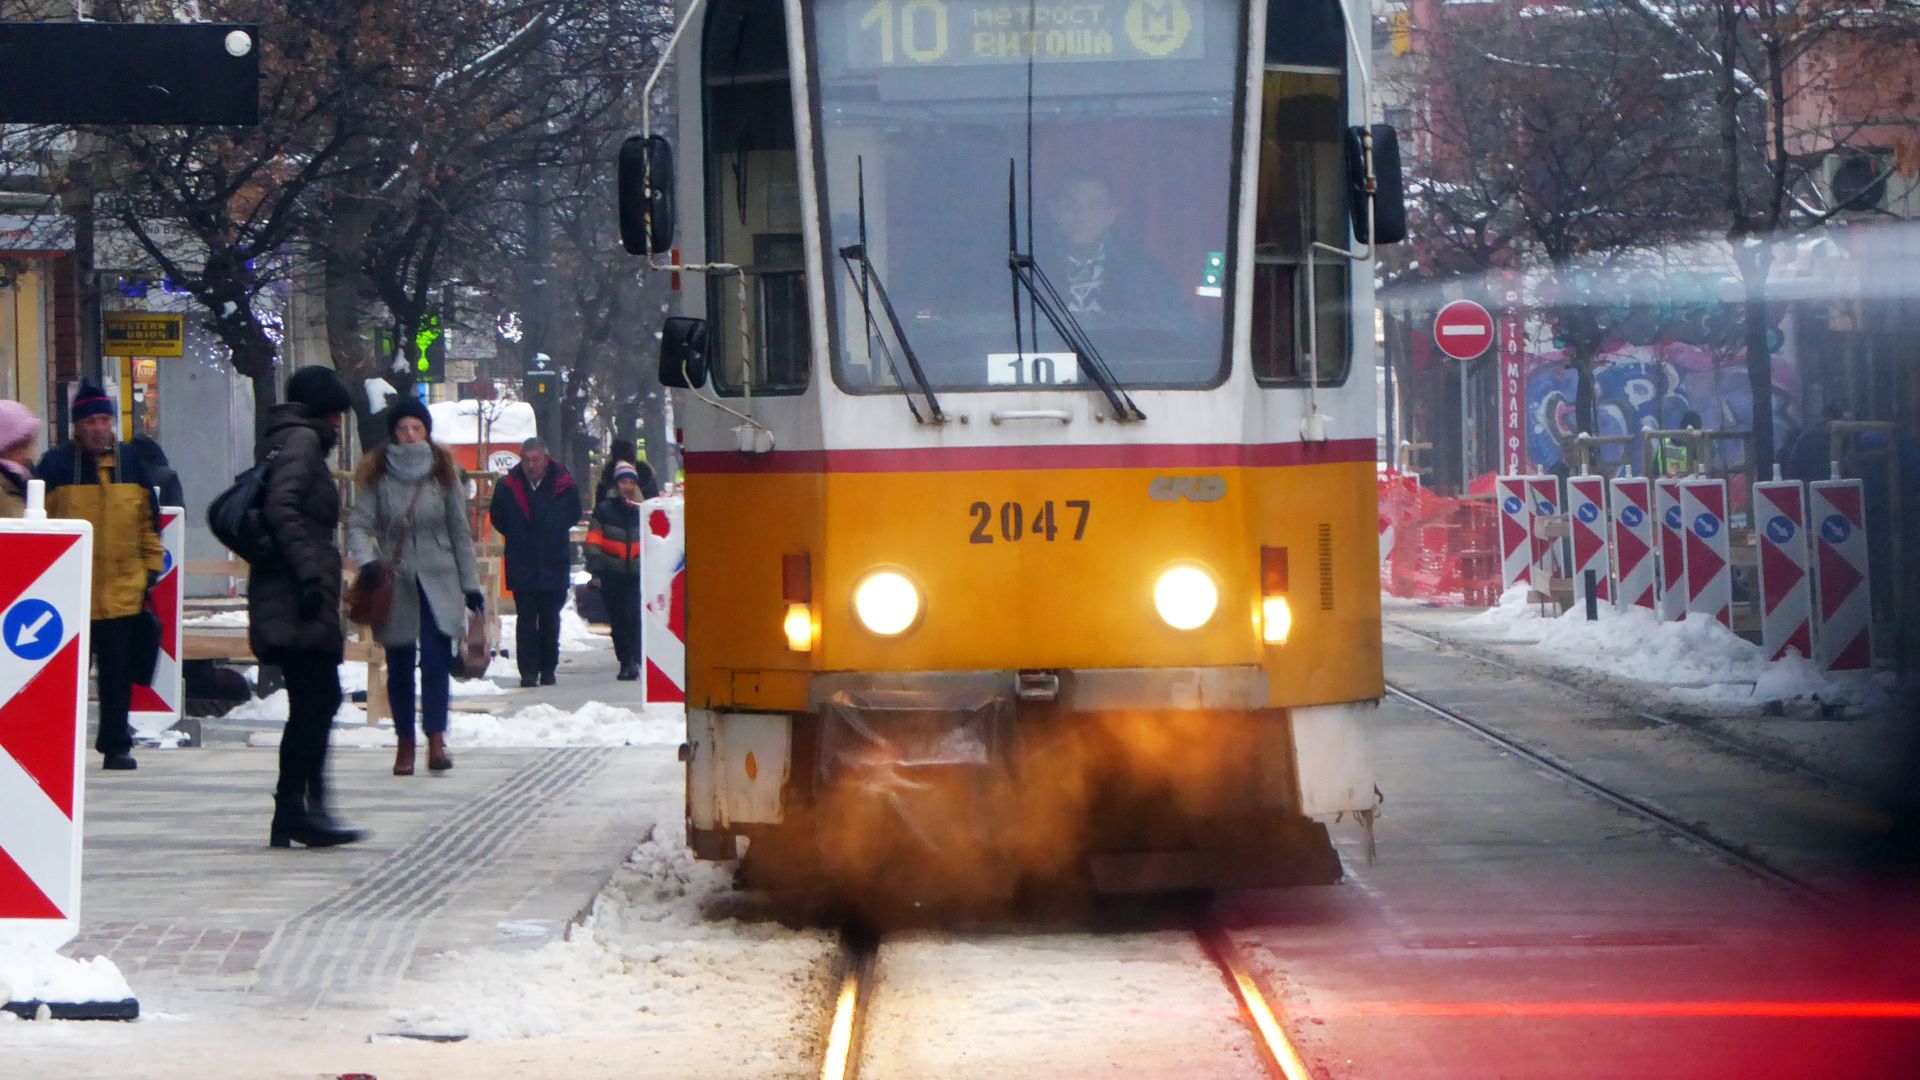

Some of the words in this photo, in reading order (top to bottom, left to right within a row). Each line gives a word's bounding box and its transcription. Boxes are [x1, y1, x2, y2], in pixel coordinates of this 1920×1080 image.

[860, 0, 949, 62] 10
[973, 29, 1114, 57] ВИТОША
[1008, 357, 1055, 384] 10
[494, 456, 513, 467] WC
[969, 500, 1090, 543] 2047
